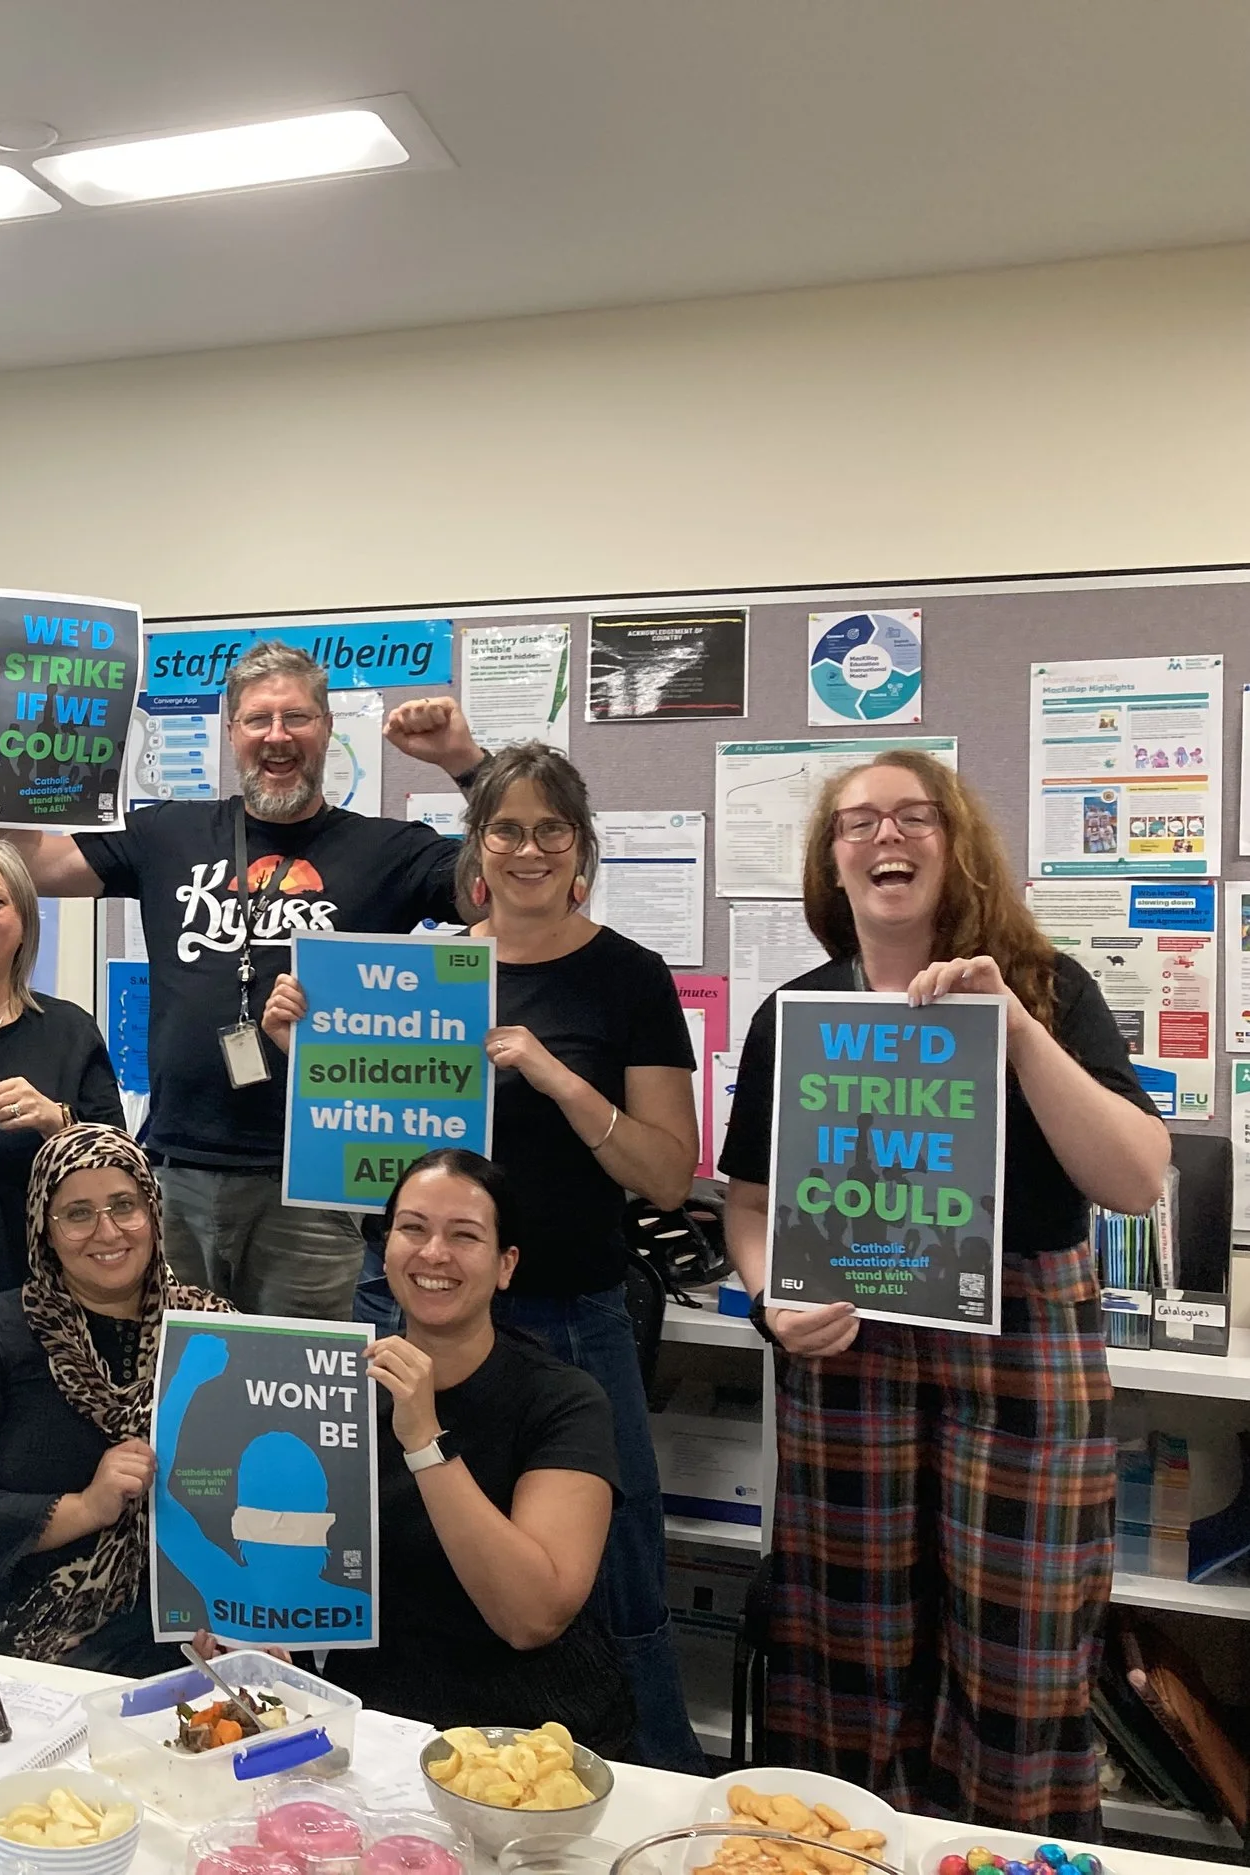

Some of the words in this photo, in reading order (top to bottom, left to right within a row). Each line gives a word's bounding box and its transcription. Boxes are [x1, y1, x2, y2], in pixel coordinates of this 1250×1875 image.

[24, 614, 115, 650] WE'D
[471, 638, 489, 646] Not
[491, 637, 517, 646] every
[480, 646, 511, 654] visible
[153, 643, 241, 686] staff
[303, 634, 434, 676] llbeing
[4, 653, 126, 690] STRIKE
[1043, 685, 1086, 695] MacKillop
[1089, 683, 1135, 694] Highlights
[153, 697, 183, 705] Converge
[184, 697, 198, 705] App
[16, 692, 46, 720] IF
[54, 695, 109, 727] WE
[755, 744, 785, 752] Glance
[34, 776, 69, 785] Catholic
[19, 786, 62, 796] education
[64, 784, 83, 793] staff
[29, 796, 53, 805] stand
[53, 794, 72, 803] with
[34, 805, 48, 813] the
[49, 804, 68, 813] AEU.
[449, 954, 479, 967] IEU
[357, 964, 419, 992] We
[678, 986, 718, 998] inutes
[311, 1007, 422, 1038] stand
[430, 1010, 465, 1041] in
[819, 1023, 956, 1064] WE'D
[309, 1056, 473, 1093] solidarity
[799, 1073, 976, 1120] STRIKE
[1180, 1093, 1208, 1105] IEU
[310, 1100, 393, 1134] with
[402, 1108, 467, 1139] the
[818, 1126, 859, 1165] IF
[870, 1129, 954, 1173] WE
[796, 1176, 974, 1227] COULD
[850, 1242, 906, 1255] Catholic
[830, 1255, 896, 1268] education
[899, 1256, 930, 1268] staff
[845, 1269, 883, 1282] stand
[885, 1269, 913, 1282] with
[781, 1278, 804, 1291] IEU
[854, 1283, 877, 1295] the
[878, 1283, 908, 1295] AEU.
[1158, 1304, 1210, 1321] Catalogues
[305, 1349, 357, 1377] WE
[245, 1379, 358, 1413] WON'T
[319, 1422, 358, 1448] BE
[175, 1468, 211, 1477] Catholic
[213, 1468, 232, 1476] staff
[207, 1478, 227, 1486] with
[188, 1487, 202, 1496] the
[204, 1487, 224, 1496] AEU.
[165, 1610, 191, 1624] IEU
[213, 1599, 363, 1630] SILENCED!
